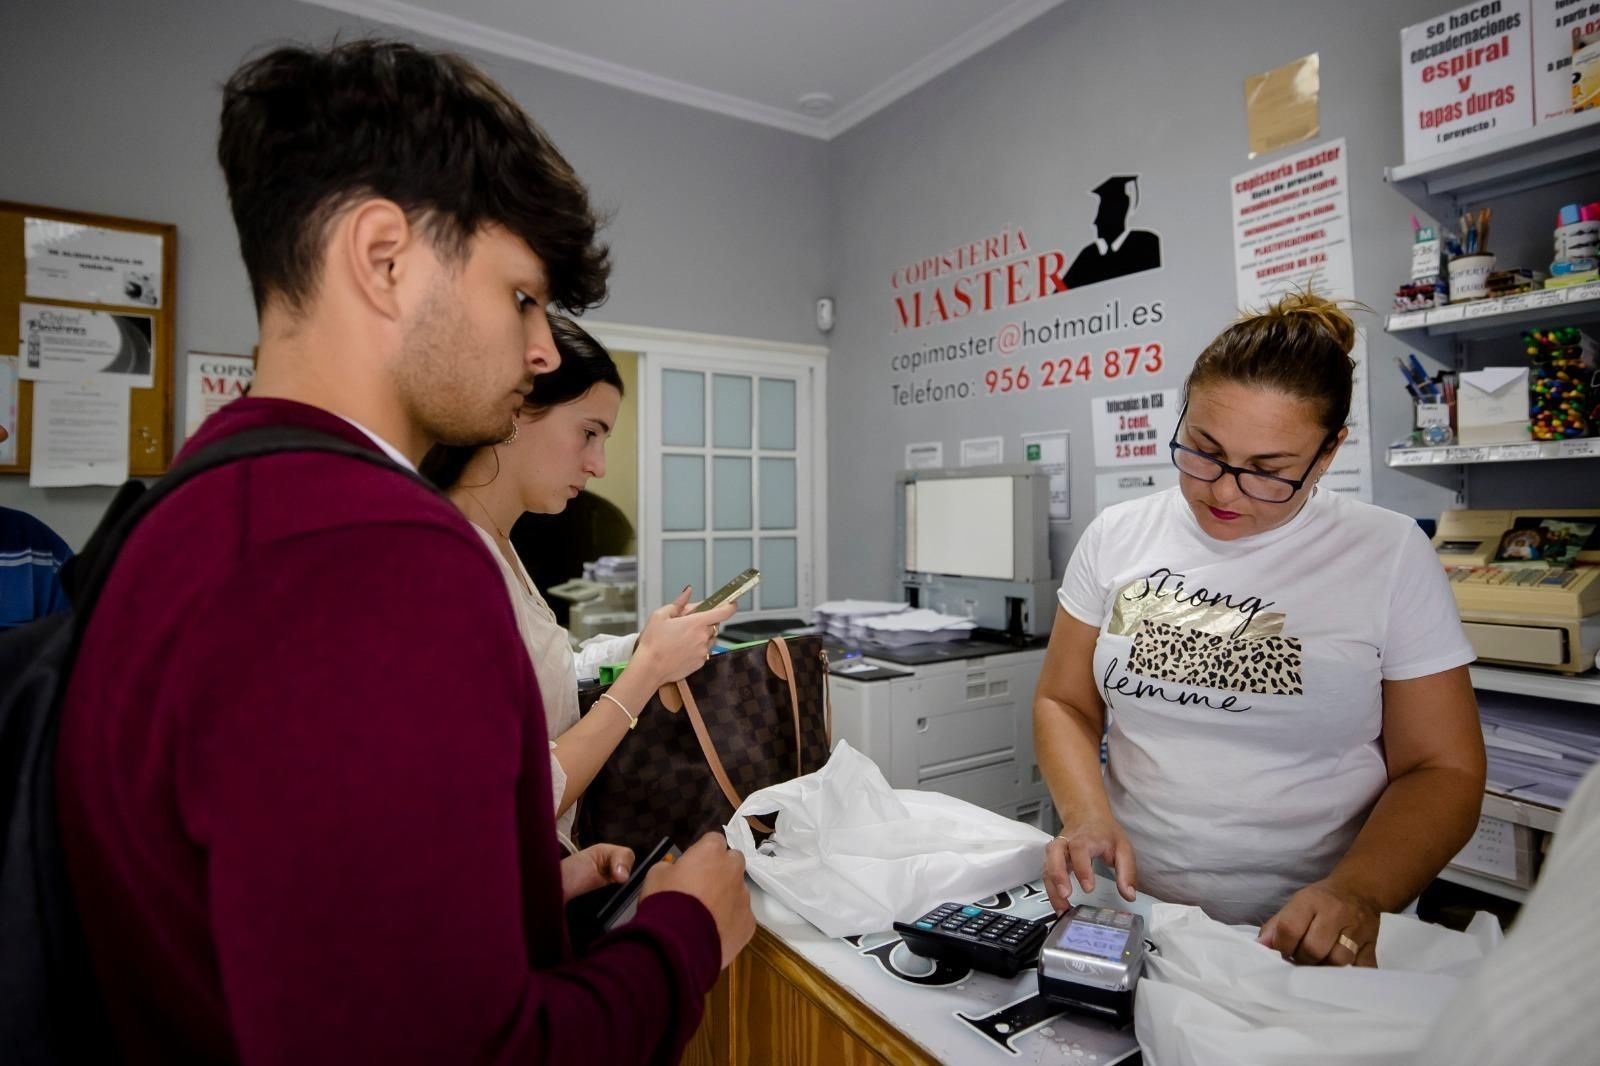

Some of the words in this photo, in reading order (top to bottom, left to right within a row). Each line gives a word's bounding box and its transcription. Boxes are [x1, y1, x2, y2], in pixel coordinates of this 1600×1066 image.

[1410, 13, 1521, 64] encuadernaciones
[1427, 21, 1445, 39] se
[1449, 0, 1502, 30] hacen
[1422, 35, 1509, 84] espiral
[1419, 101, 1462, 130] tapas
[1467, 84, 1515, 116] duras
[1443, 121, 1490, 142] proyecto
[1296, 147, 1340, 172] master
[893, 250, 1070, 333] MASTER
[891, 300, 1164, 373] copimaster@hotmail.es
[200, 362, 253, 377] COPIS
[201, 375, 245, 395] MA
[985, 365, 1031, 395] 956
[1040, 355, 1092, 388] 224
[1103, 342, 1164, 380] 873
[1119, 415, 1125, 430] 3
[1123, 568, 1276, 640] Strong
[1103, 657, 1252, 713] femme
